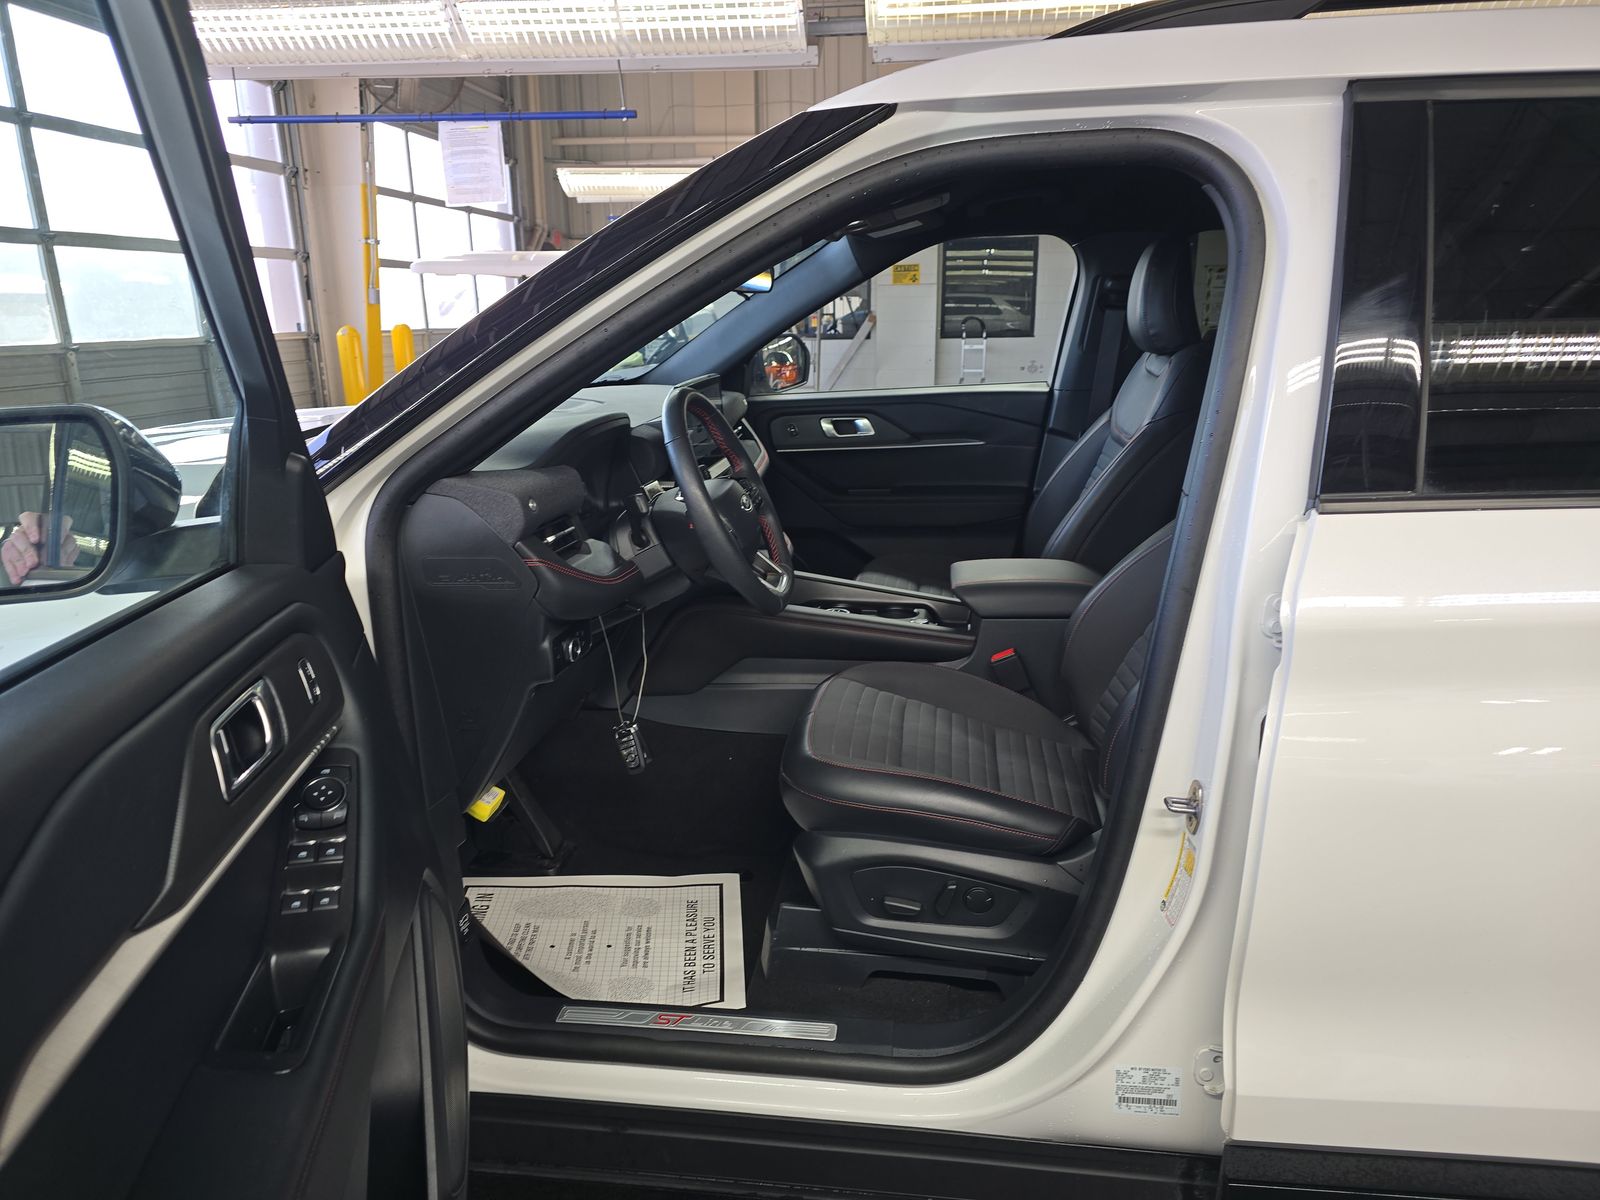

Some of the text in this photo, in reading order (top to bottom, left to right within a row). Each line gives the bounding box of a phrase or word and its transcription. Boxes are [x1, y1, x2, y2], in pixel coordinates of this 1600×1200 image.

[474, 893, 494, 901] IN
[685, 899, 698, 937] PLEASURE
[566, 937, 575, 956] customer
[577, 934, 587, 954] important
[702, 916, 715, 974] TO SERVE YOU
[620, 957, 629, 967] Your
[632, 947, 640, 968] improving
[684, 946, 696, 967] BEEN
[683, 970, 696, 986] HAS
[653, 1013, 692, 1025] ST
